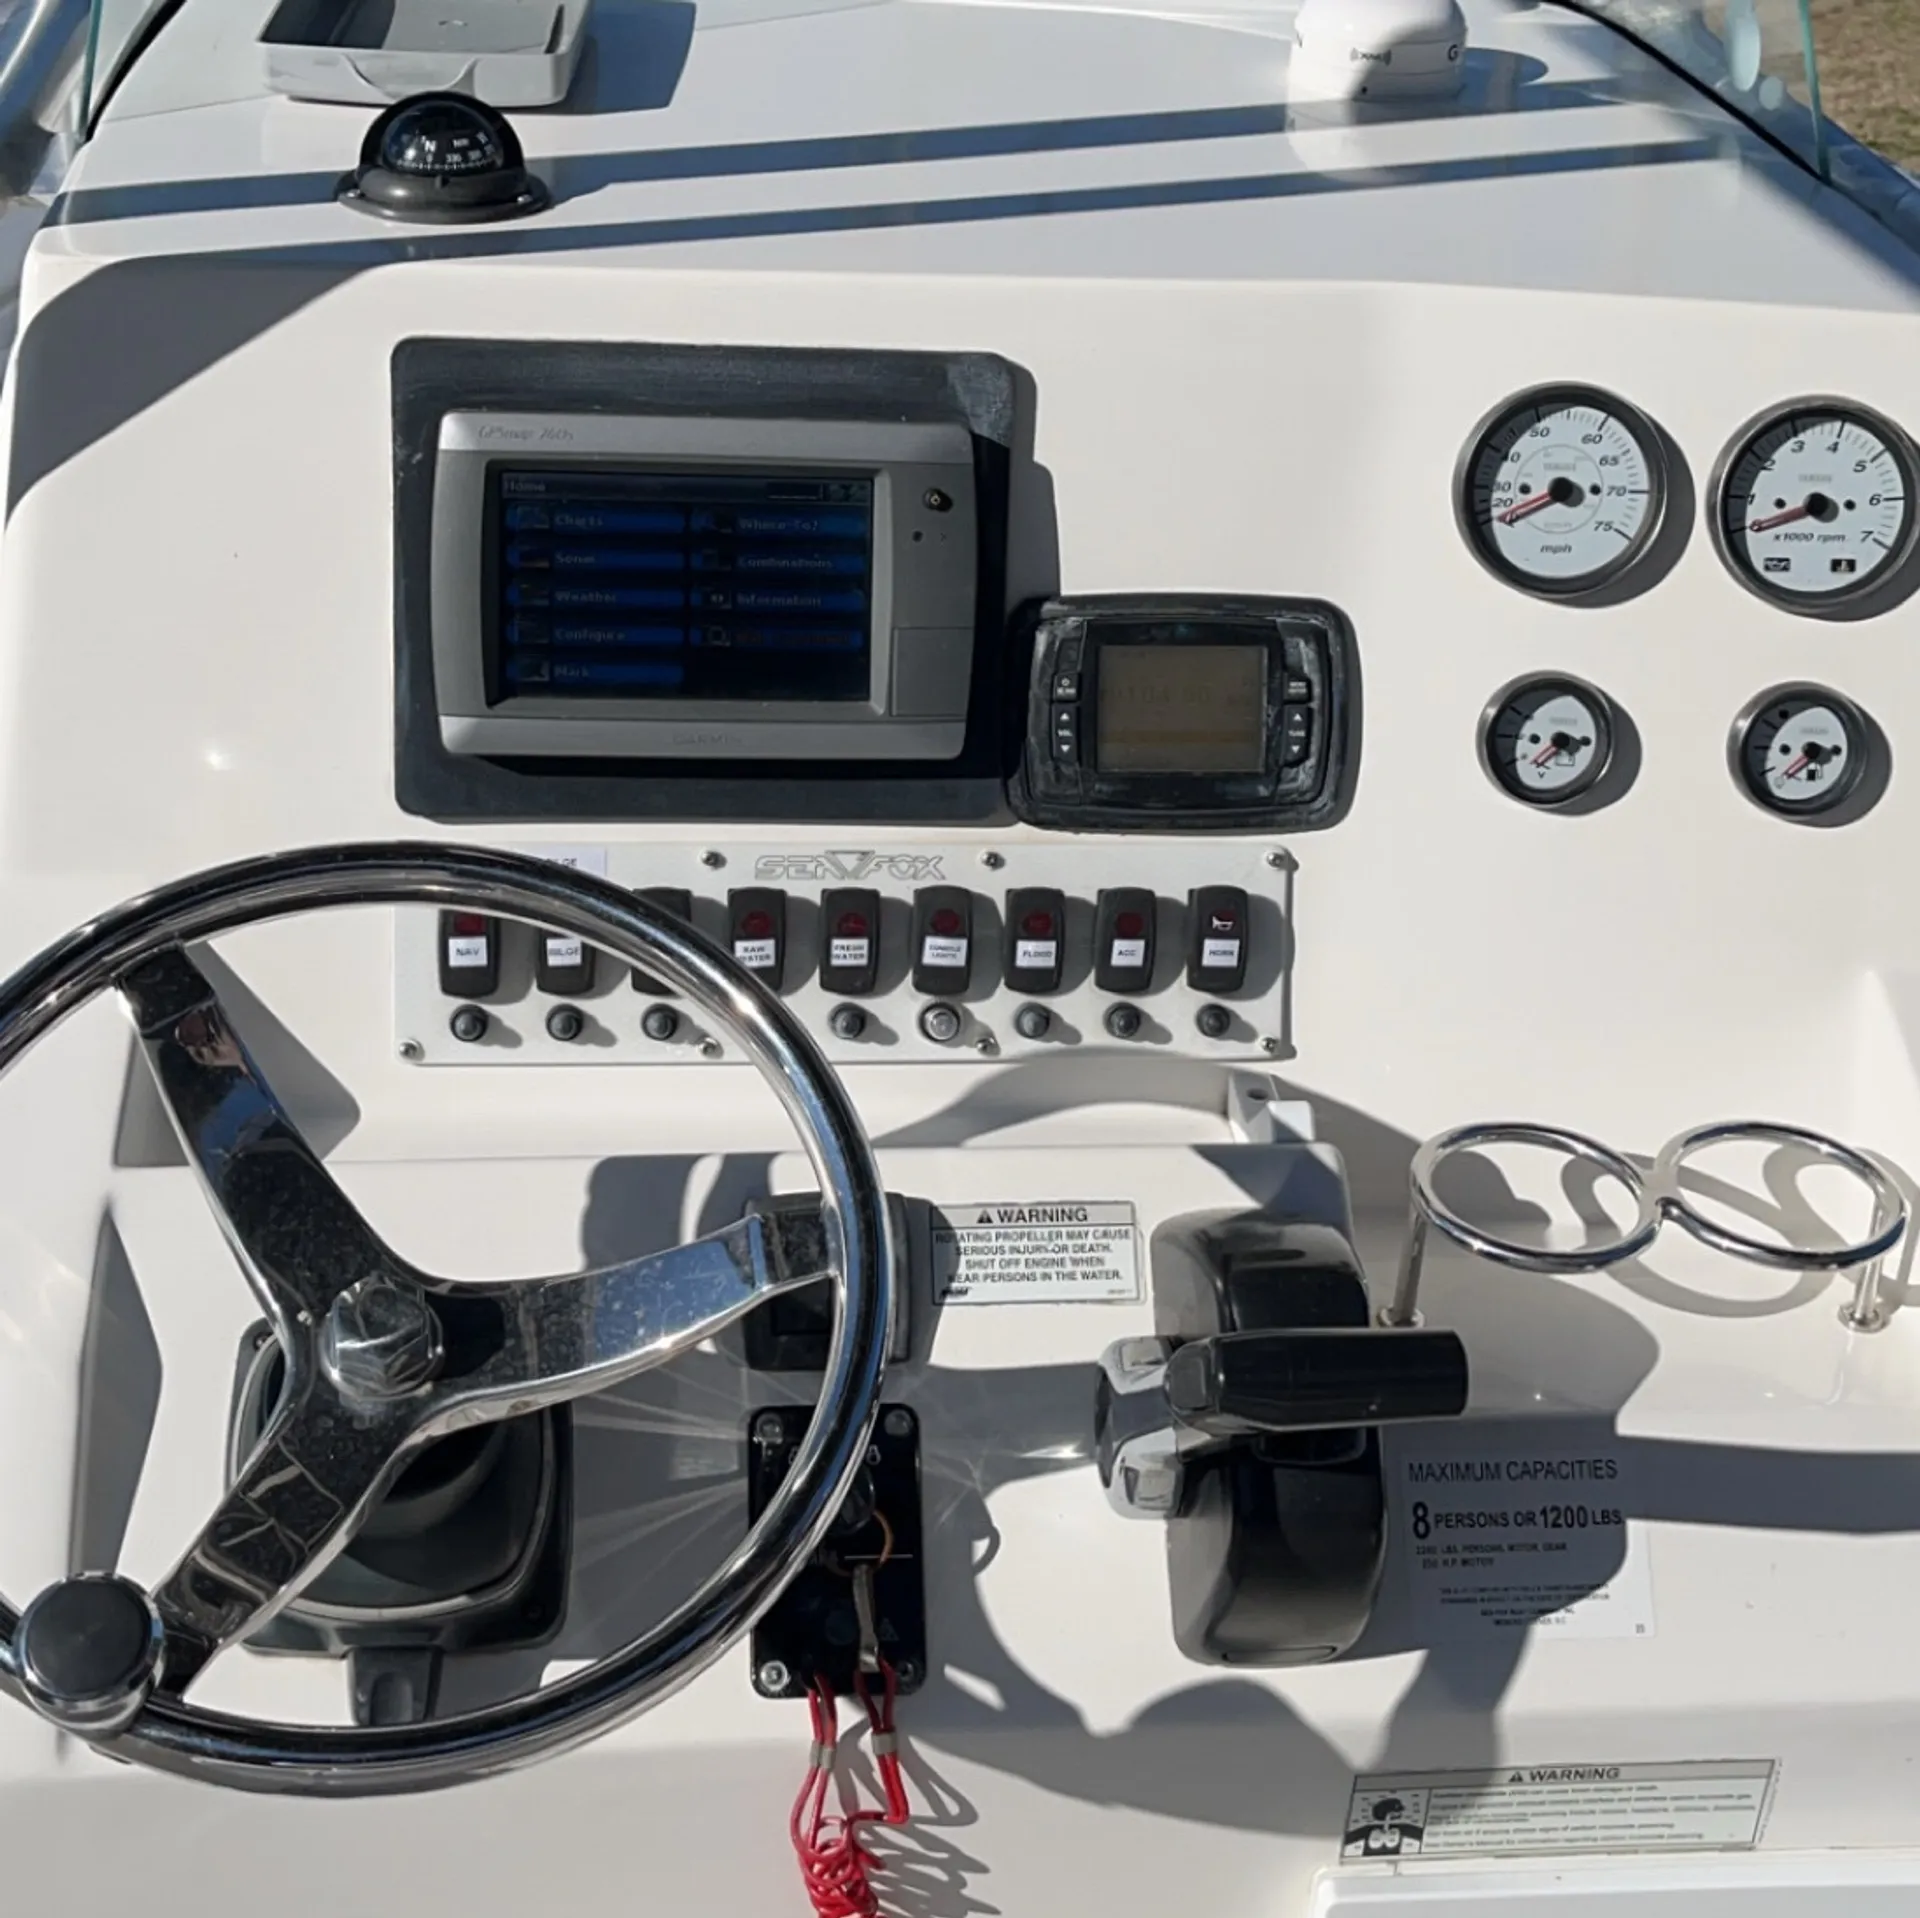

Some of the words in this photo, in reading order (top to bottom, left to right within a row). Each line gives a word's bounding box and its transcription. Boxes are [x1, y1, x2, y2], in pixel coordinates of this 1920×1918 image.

[424, 140, 436, 153] N
[1529, 427, 1550, 438] 50
[1581, 434, 1603, 445] 60
[1790, 440, 1805, 454] 3
[1826, 441, 1840, 454] 4
[1599, 455, 1619, 467] 65
[1761, 459, 1776, 471] 2
[1853, 460, 1867, 473] 5
[504, 480, 546, 493] Home
[1606, 486, 1627, 497] 70
[1492, 498, 1513, 508] 20
[1869, 494, 1882, 506] 6
[555, 514, 603, 527] Charts
[1594, 521, 1613, 532] 75
[1817, 533, 1846, 543] rpm
[1860, 531, 1874, 543] 7
[1540, 544, 1573, 555] mph
[555, 591, 617, 603] Weather
[555, 628, 626, 642] Configure
[554, 666, 590, 678] Mark
[456, 947, 479, 956] NAV
[1023, 950, 1053, 958] FLOOD
[1118, 949, 1136, 957] ACC
[1209, 949, 1234, 957] HORN
[996, 1208, 1088, 1224] WARNING
[995, 1230, 1063, 1242] PROPELLER
[1066, 1229, 1089, 1241] MAY
[1094, 1228, 1131, 1240] CAUSE
[956, 1244, 1006, 1257] SERIOUS
[965, 1258, 996, 1270] SHUT
[999, 1257, 1022, 1269] OFF
[1025, 1257, 1067, 1269] ENGINE
[1069, 1256, 1106, 1268] WHEN
[983, 1271, 1037, 1283] PERSONS
[1040, 1271, 1053, 1282] IN
[1056, 1270, 1078, 1282] THE
[1081, 1270, 1123, 1282] WATER.
[1408, 1462, 1500, 1483] MAXIMUM
[1506, 1459, 1619, 1482] CAPACITIES
[1412, 1501, 1431, 1540] 8
[1434, 1511, 1510, 1529] PERSONS
[1513, 1511, 1537, 1527] OR
[1540, 1505, 1589, 1529] 1200
[1529, 1767, 1621, 1782] WARNING
